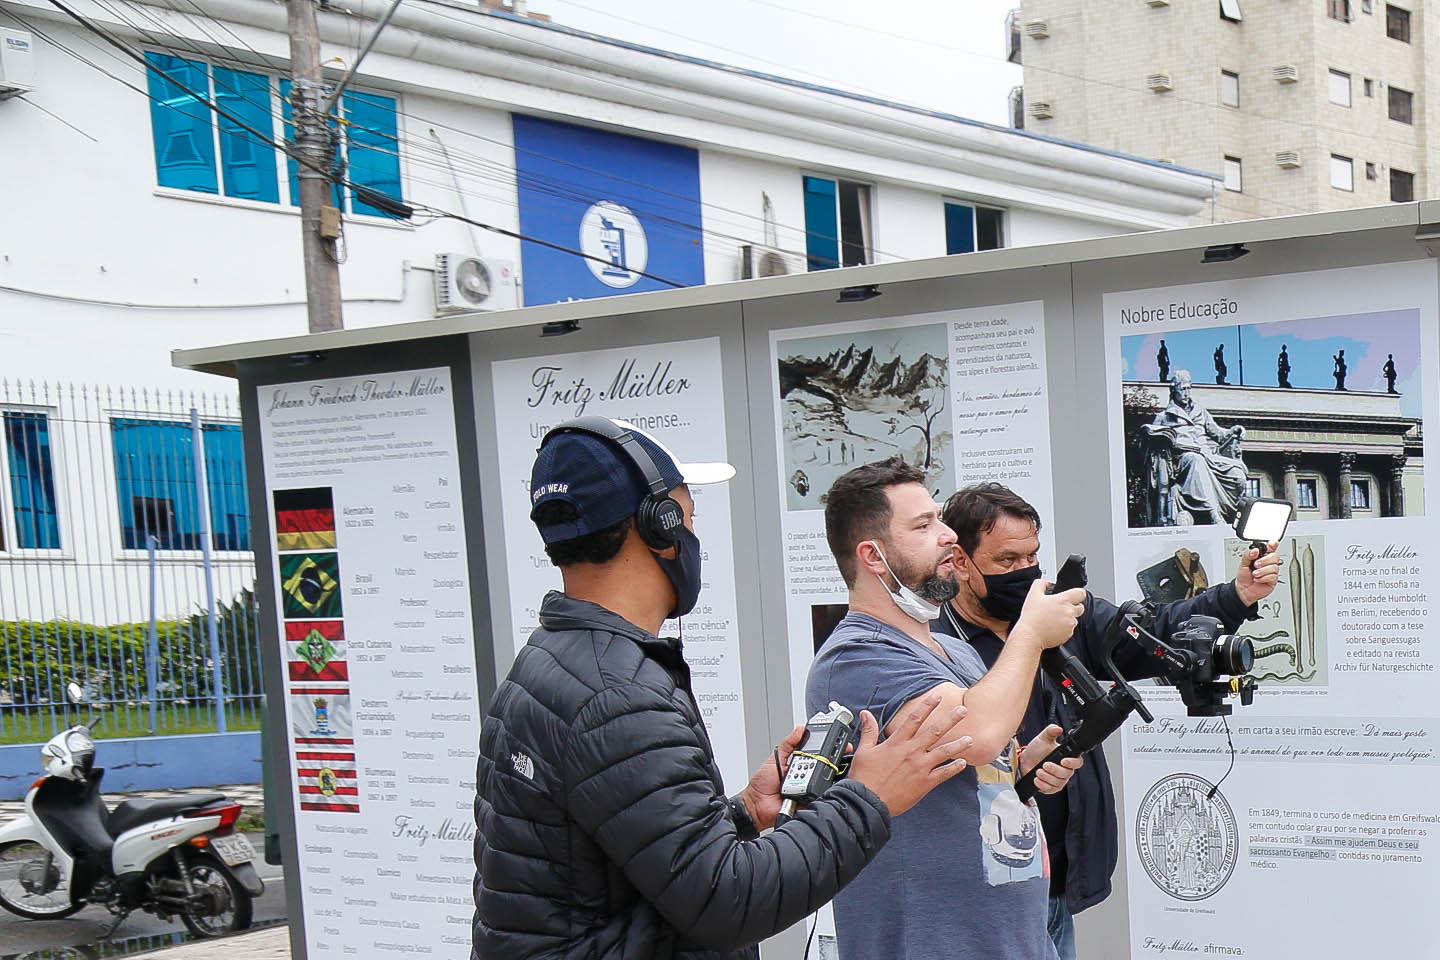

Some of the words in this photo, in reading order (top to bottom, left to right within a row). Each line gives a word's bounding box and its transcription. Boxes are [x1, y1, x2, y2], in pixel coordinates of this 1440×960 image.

[1121, 305, 1165, 325] Nobre
[1169, 297, 1238, 321] Educação
[527, 365, 594, 414] Fritz
[599, 358, 691, 401] Müller
[548, 483, 568, 494] WEAR
[343, 505, 374, 517] Alemanha
[663, 509, 682, 530] JBL
[1344, 543, 1376, 565] Fritz
[1377, 542, 1417, 560] Müller
[1342, 566, 1378, 578] Forma-se
[1379, 567, 1390, 577] no
[1391, 564, 1409, 576] final
[1409, 564, 1420, 576] de
[1343, 580, 1363, 593] 1844
[1362, 580, 1377, 591] em
[1377, 578, 1409, 590] filosofia
[1409, 580, 1420, 590] na
[1337, 592, 1387, 606] Universidade
[1387, 591, 1427, 604] Humboldt
[1334, 661, 1358, 673] Archiv
[1359, 661, 1371, 673] für
[1371, 661, 1434, 675] Naturgeschichte
[1142, 935, 1167, 955] Fritz
[1167, 938, 1199, 953] Müller
